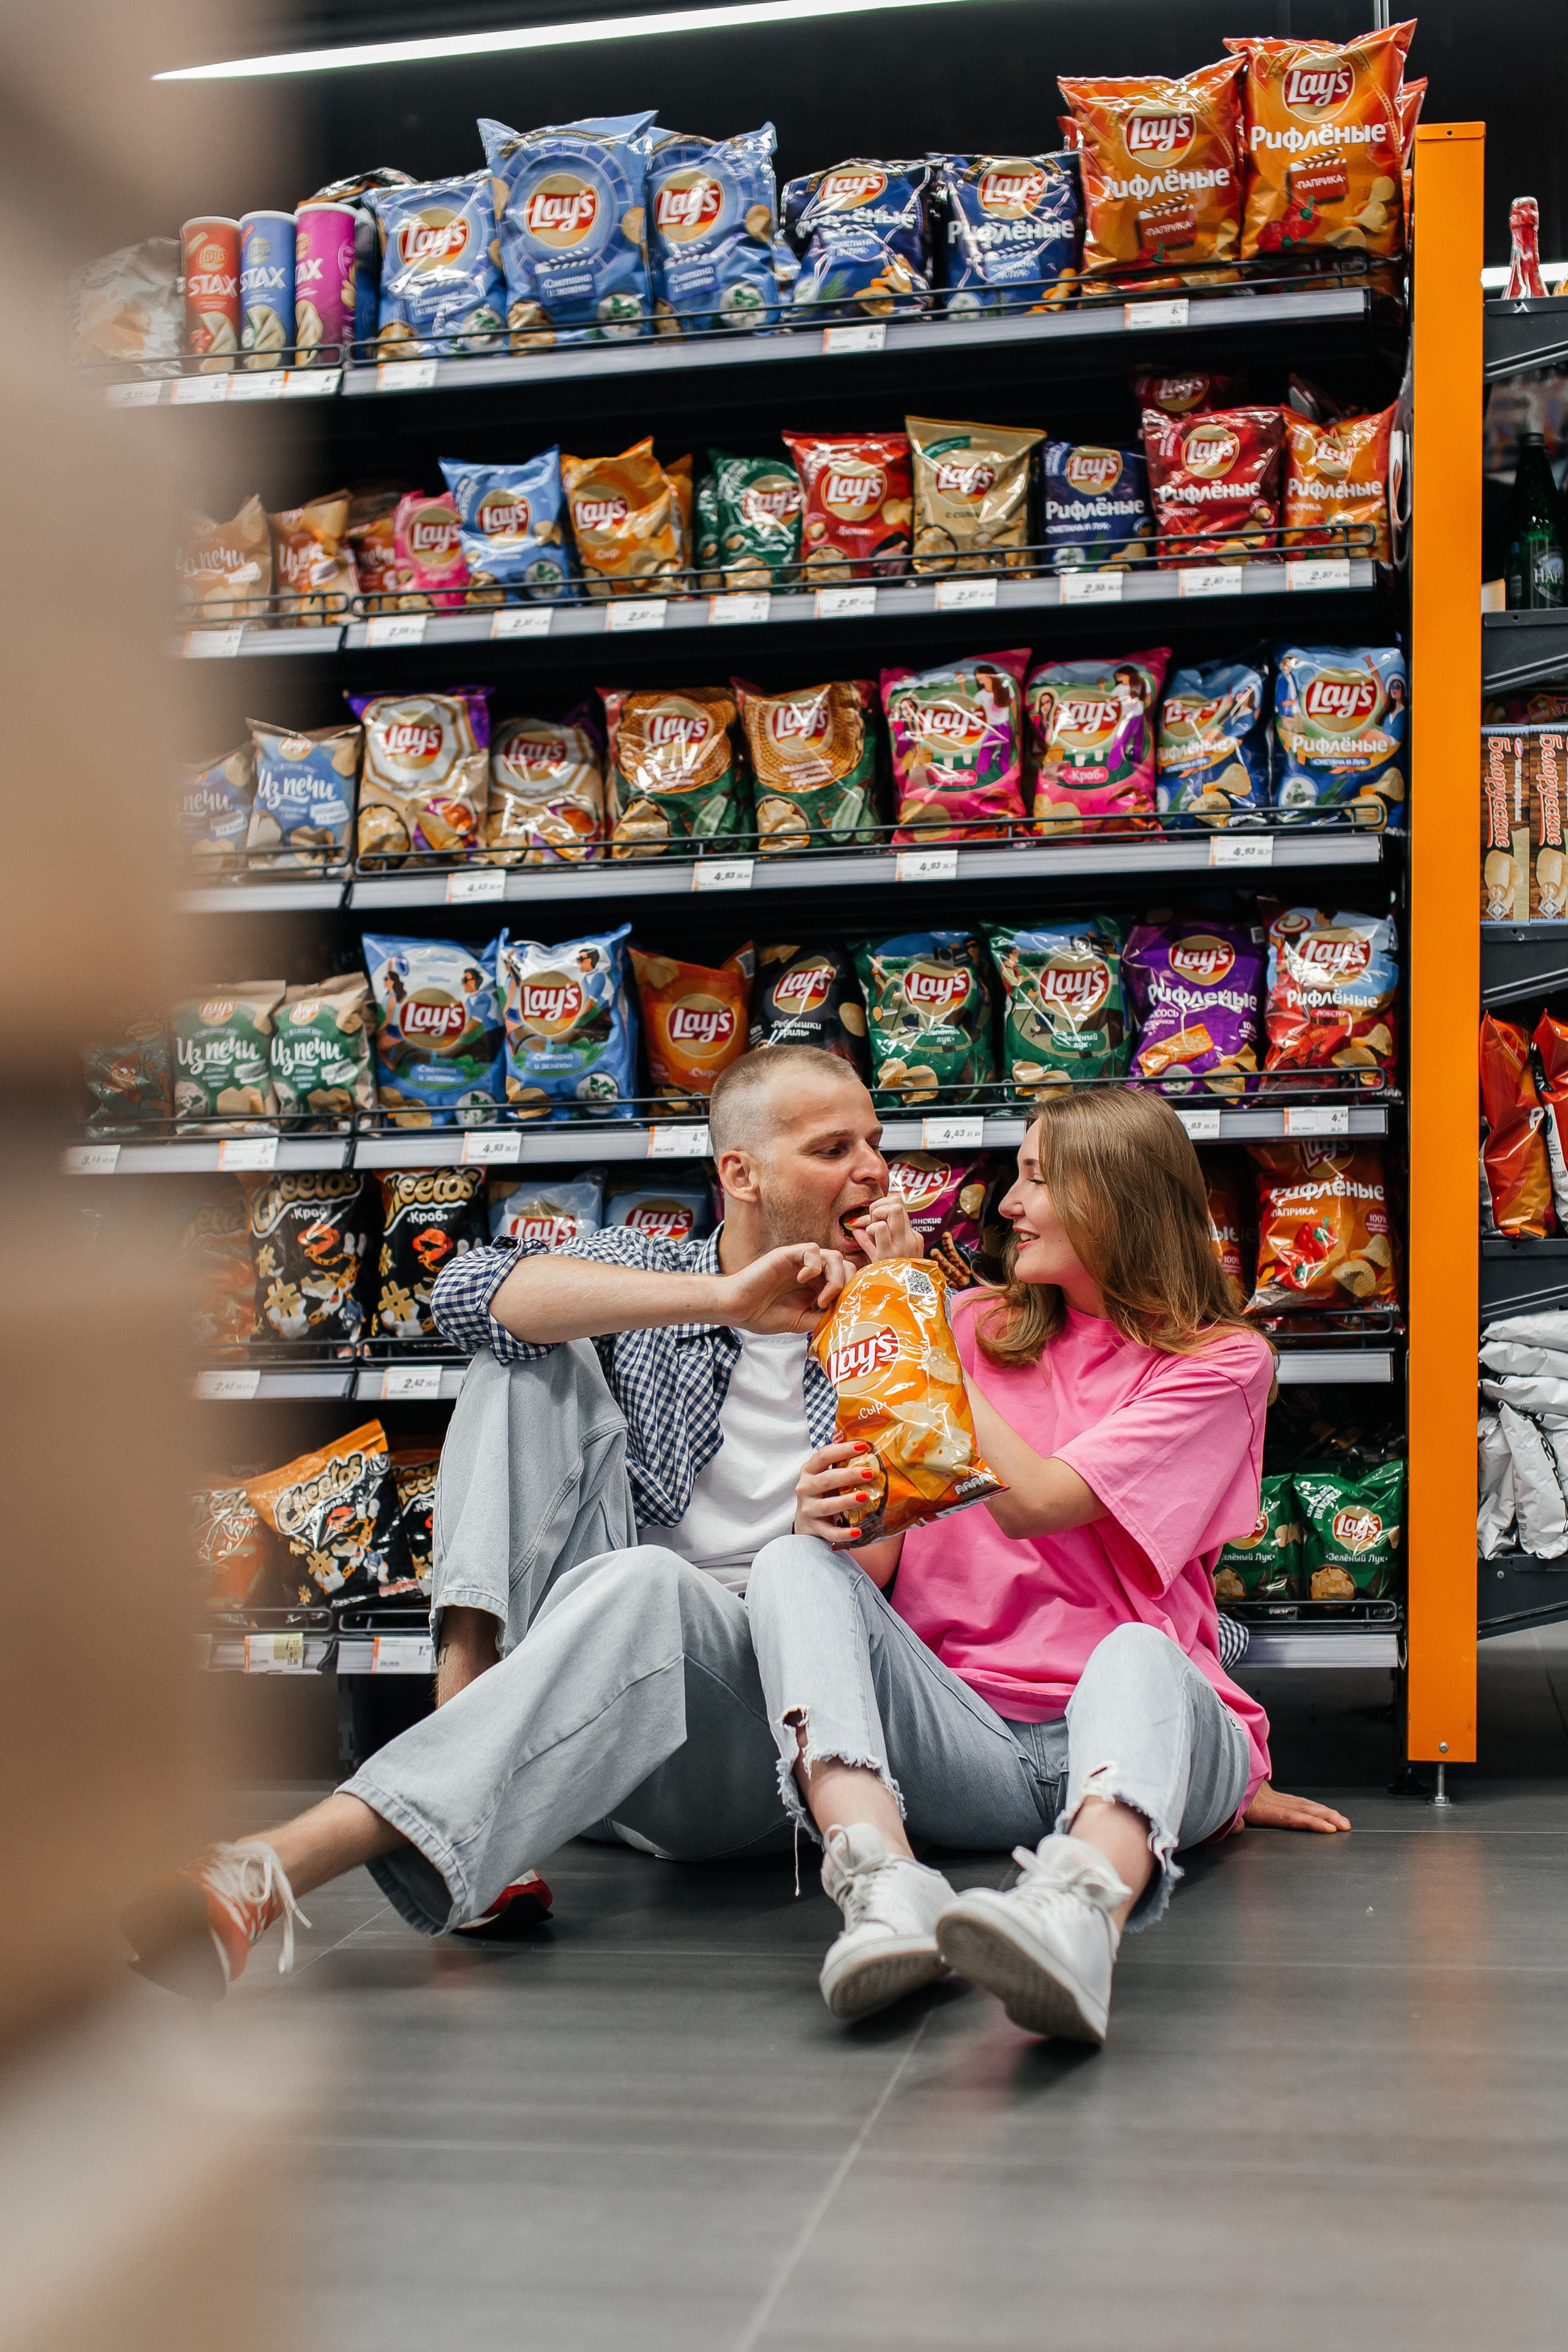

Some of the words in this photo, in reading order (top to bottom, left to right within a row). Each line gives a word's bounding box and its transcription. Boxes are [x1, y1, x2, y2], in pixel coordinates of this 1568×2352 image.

[1288, 67, 1349, 107] Lay's
[1131, 113, 1191, 151] Lay's
[1251, 122, 1387, 153] Рифлёные
[823, 172, 882, 202] Lay's
[984, 170, 1046, 208] Lay's
[1102, 167, 1230, 200] Рифлёные
[531, 189, 597, 232] Lay's
[659, 180, 720, 224] Lay's
[402, 221, 468, 259] Lay's
[948, 219, 1075, 249] Рифлёные
[188, 274, 238, 298] STAX
[240, 265, 286, 294] STAX
[1187, 437, 1237, 464] Lay's
[938, 464, 996, 494] Lay's
[1072, 454, 1119, 484] Lay's
[826, 474, 884, 507] Lay's
[1156, 479, 1261, 505] Рифлёные
[1288, 477, 1383, 500] Рифлёные
[483, 500, 529, 535] Lay's
[575, 497, 627, 530] Lay's
[1046, 496, 1145, 521] Рифлёные
[413, 518, 461, 554] Lay's
[1309, 680, 1373, 719] Lay's
[653, 716, 709, 747] Lay's
[776, 705, 828, 739] Lay's
[921, 707, 984, 738] Lay's
[1061, 700, 1120, 734] Lay's
[387, 722, 442, 757] Lay's
[508, 738, 565, 771] Lay's
[1292, 733, 1388, 755] Рифлёные
[257, 767, 280, 810] Из
[283, 773, 336, 800] печи
[1068, 770, 1104, 782] «Краб»
[1537, 733, 1564, 846] Белорусские
[1485, 736, 1511, 848] Белорусские
[1174, 944, 1231, 974] Lay's
[777, 968, 834, 1000] Lay's
[912, 972, 967, 1005] Lay's
[1045, 965, 1106, 1004] Lay's
[1287, 987, 1379, 1009] Рифлёные
[523, 984, 582, 1021] Lay's
[405, 1003, 464, 1036] Lay's
[673, 1008, 733, 1043] Lay's
[937, 1035, 955, 1044] лук»
[176, 1036, 205, 1076] Из
[206, 1036, 260, 1061] печи
[271, 1038, 292, 1076] Из
[294, 1038, 344, 1062] печи
[483, 1143, 504, 1153] 4.93
[943, 1129, 965, 1140] 4.43
[1270, 1173, 1385, 1202] Рифлёные
[407, 1209, 448, 1224] «Краб»
[630, 1208, 692, 1238] Lay's
[1271, 1206, 1318, 1219] «ПАПРИКА»
[1370, 1213, 1387, 1224] 100%
[831, 1332, 899, 1383] Lay's
[404, 1378, 424, 1389] 2.42
[858, 1401, 888, 1420] «Сыр»
[277, 1455, 364, 1531] Cheetos
[1336, 1514, 1379, 1542] Lay's
[1254, 1553, 1276, 1564] Лук»
[1326, 1553, 1366, 1562] «Зелёный
[1368, 1554, 1388, 1565] Лук»
